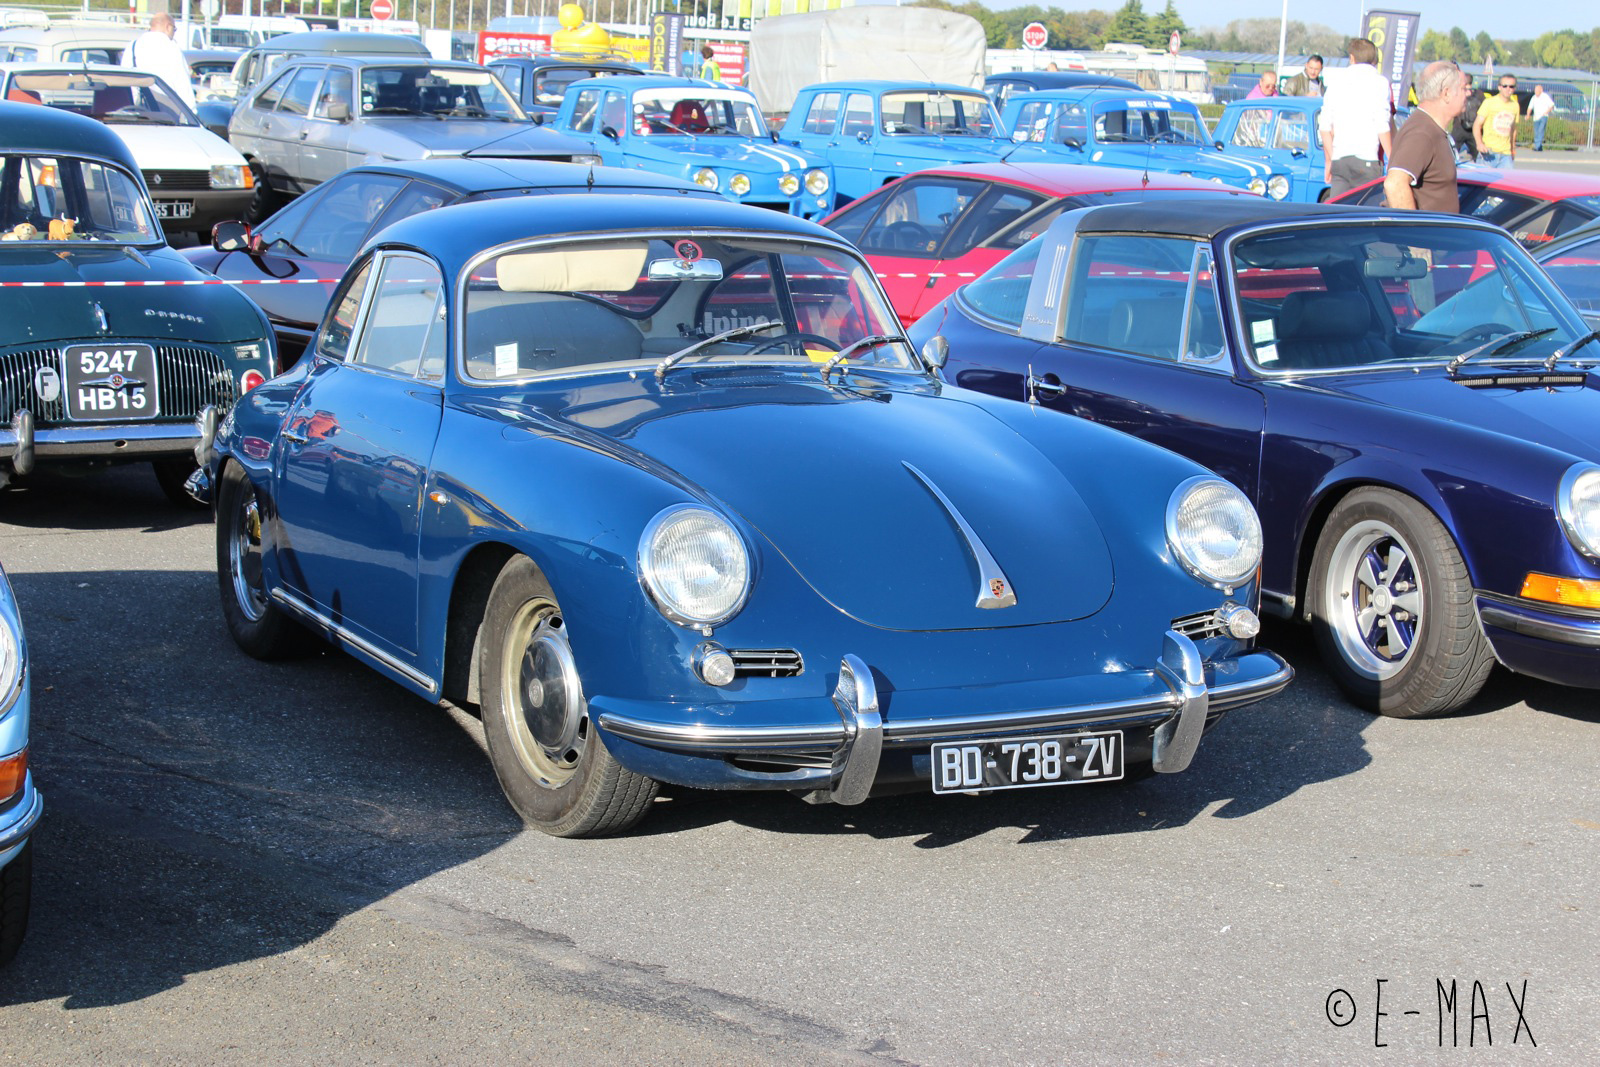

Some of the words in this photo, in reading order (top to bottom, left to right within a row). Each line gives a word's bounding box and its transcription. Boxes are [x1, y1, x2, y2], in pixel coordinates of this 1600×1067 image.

[484, 36, 547, 53] SORTIE
[1026, 31, 1045, 41] STOP
[1392, 19, 1409, 81] COLLECTION
[80, 350, 138, 374] 5247
[40, 371, 54, 397] F
[941, 736, 1116, 788] BD-738-ZV
